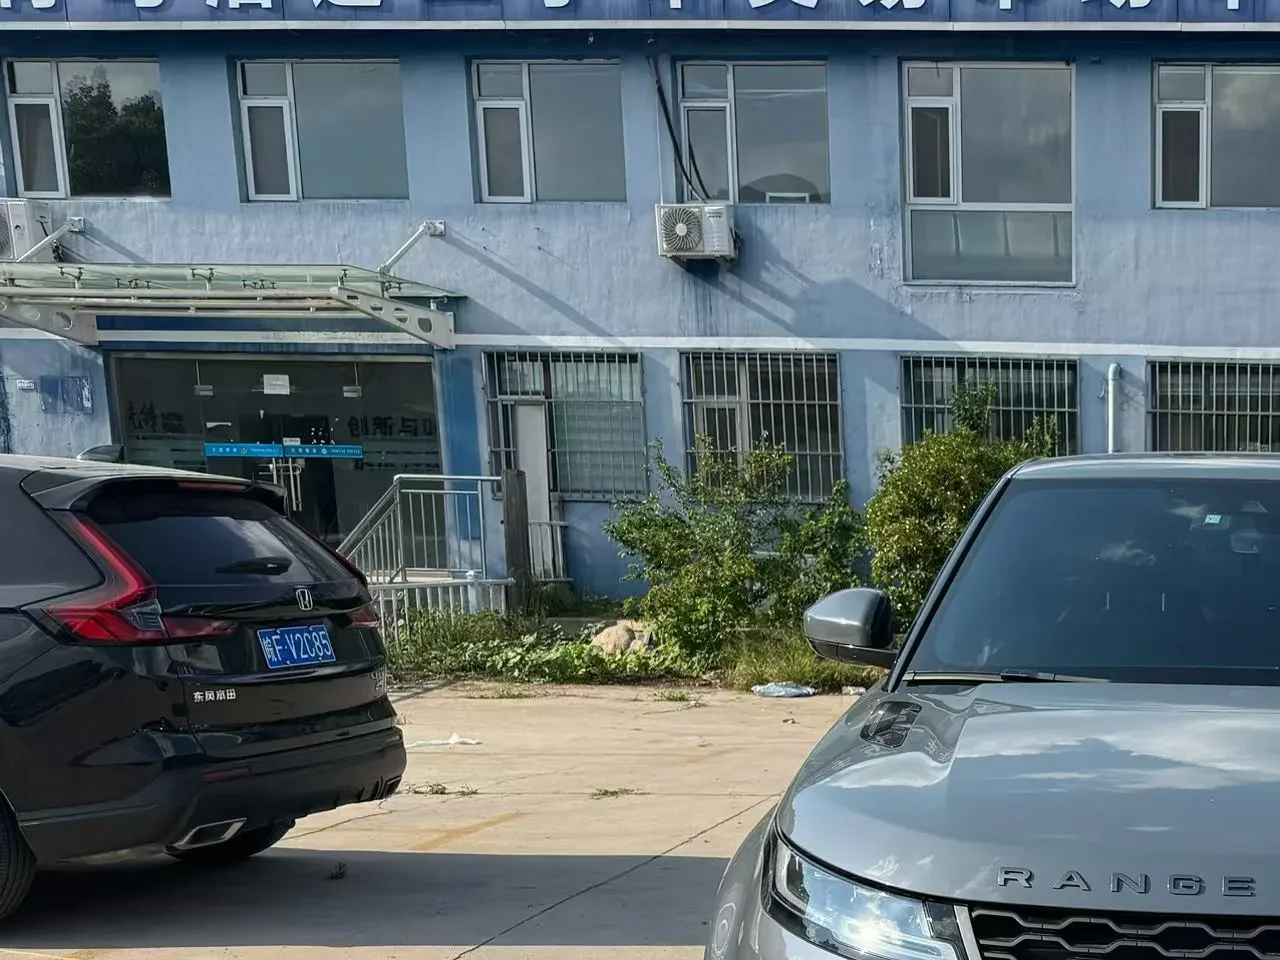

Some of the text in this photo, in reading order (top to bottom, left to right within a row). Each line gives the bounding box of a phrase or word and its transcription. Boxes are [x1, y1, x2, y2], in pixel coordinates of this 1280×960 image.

[193, 688, 237, 703] 东风本田
[997, 866, 1257, 898] RANGE
